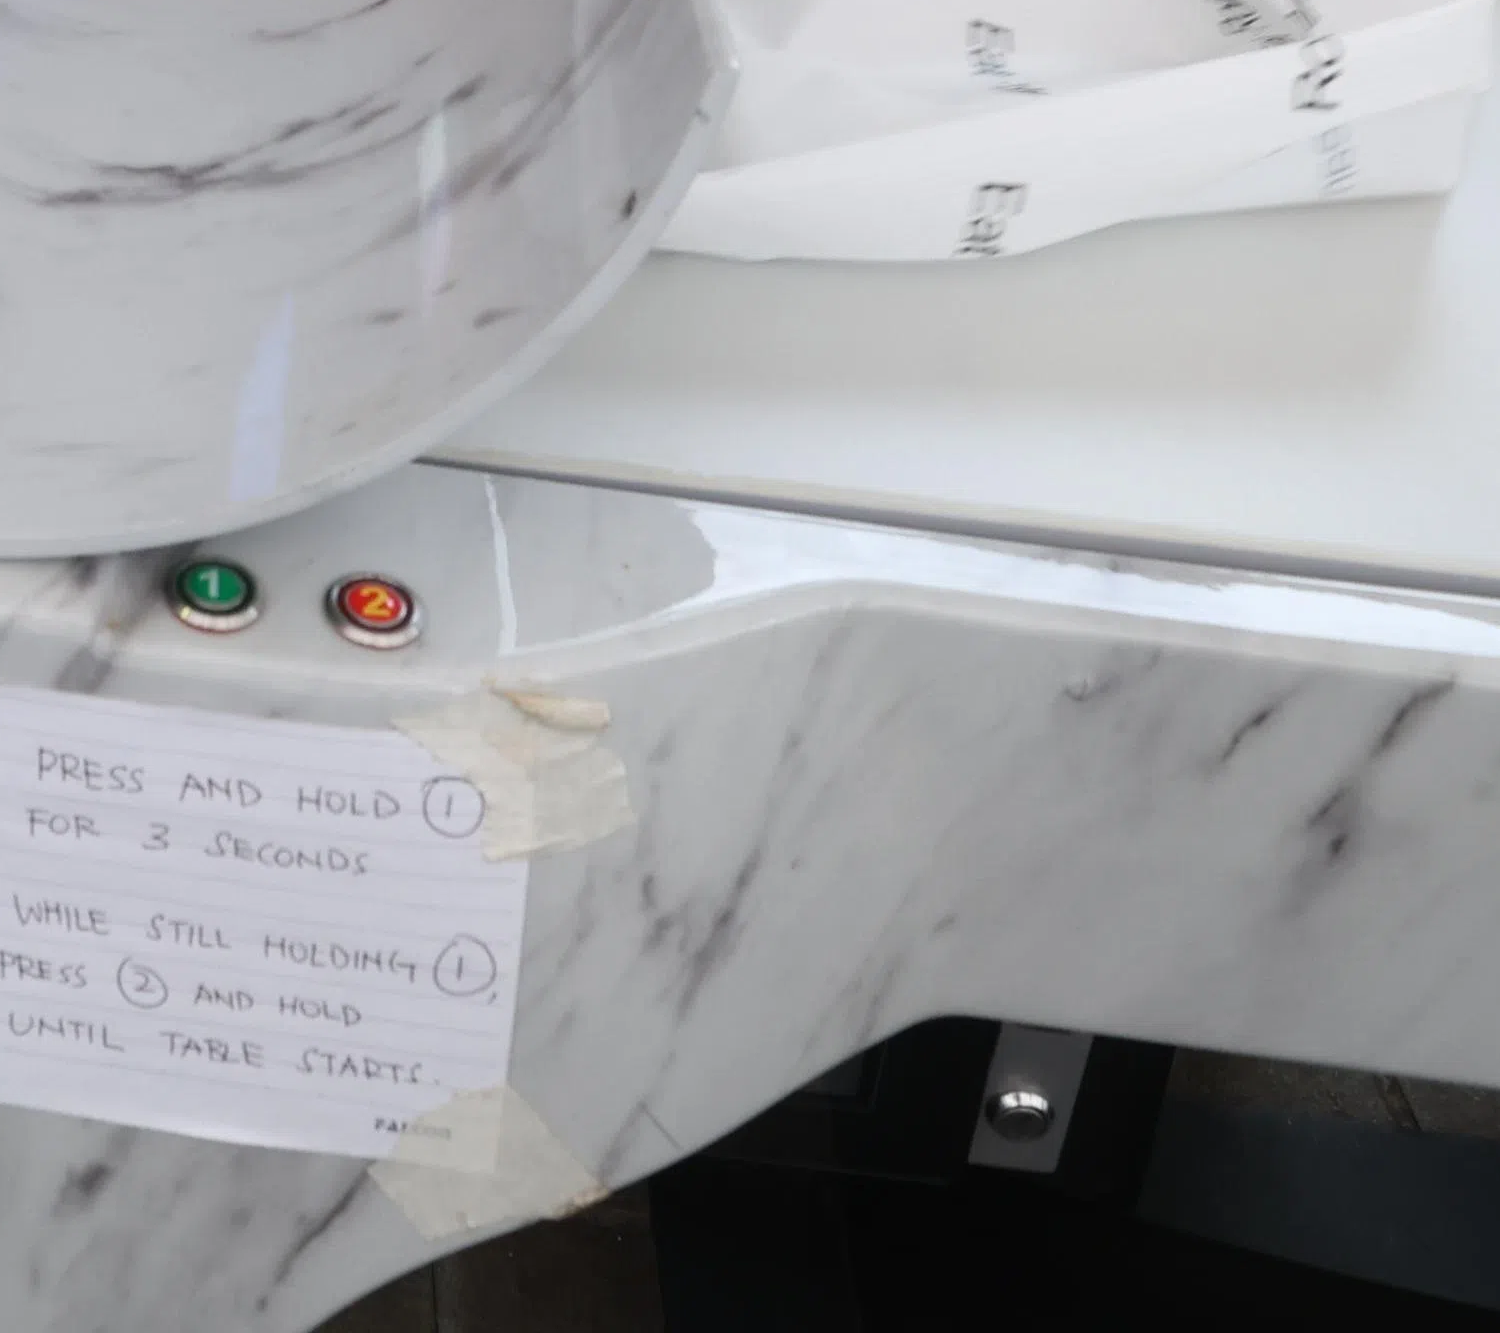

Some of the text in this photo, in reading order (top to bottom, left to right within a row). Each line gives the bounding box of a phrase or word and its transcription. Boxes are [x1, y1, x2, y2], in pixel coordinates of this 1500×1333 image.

[199, 568, 221, 599] 1
[360, 587, 391, 618] 2
[37, 745, 145, 794] PRESS
[179, 772, 263, 809] AND
[297, 785, 401, 820] HOLD
[26, 808, 370, 876] FOR 3 SECONDS
[12, 893, 110, 936] WHILE
[146, 913, 232, 950] STILL
[263, 933, 418, 984] HOLDING
[193, 982, 255, 1012] AND
[278, 994, 363, 1028] HOLD
[7, 1011, 126, 1053] UNTIL
[158, 1030, 266, 1069] TABLE
